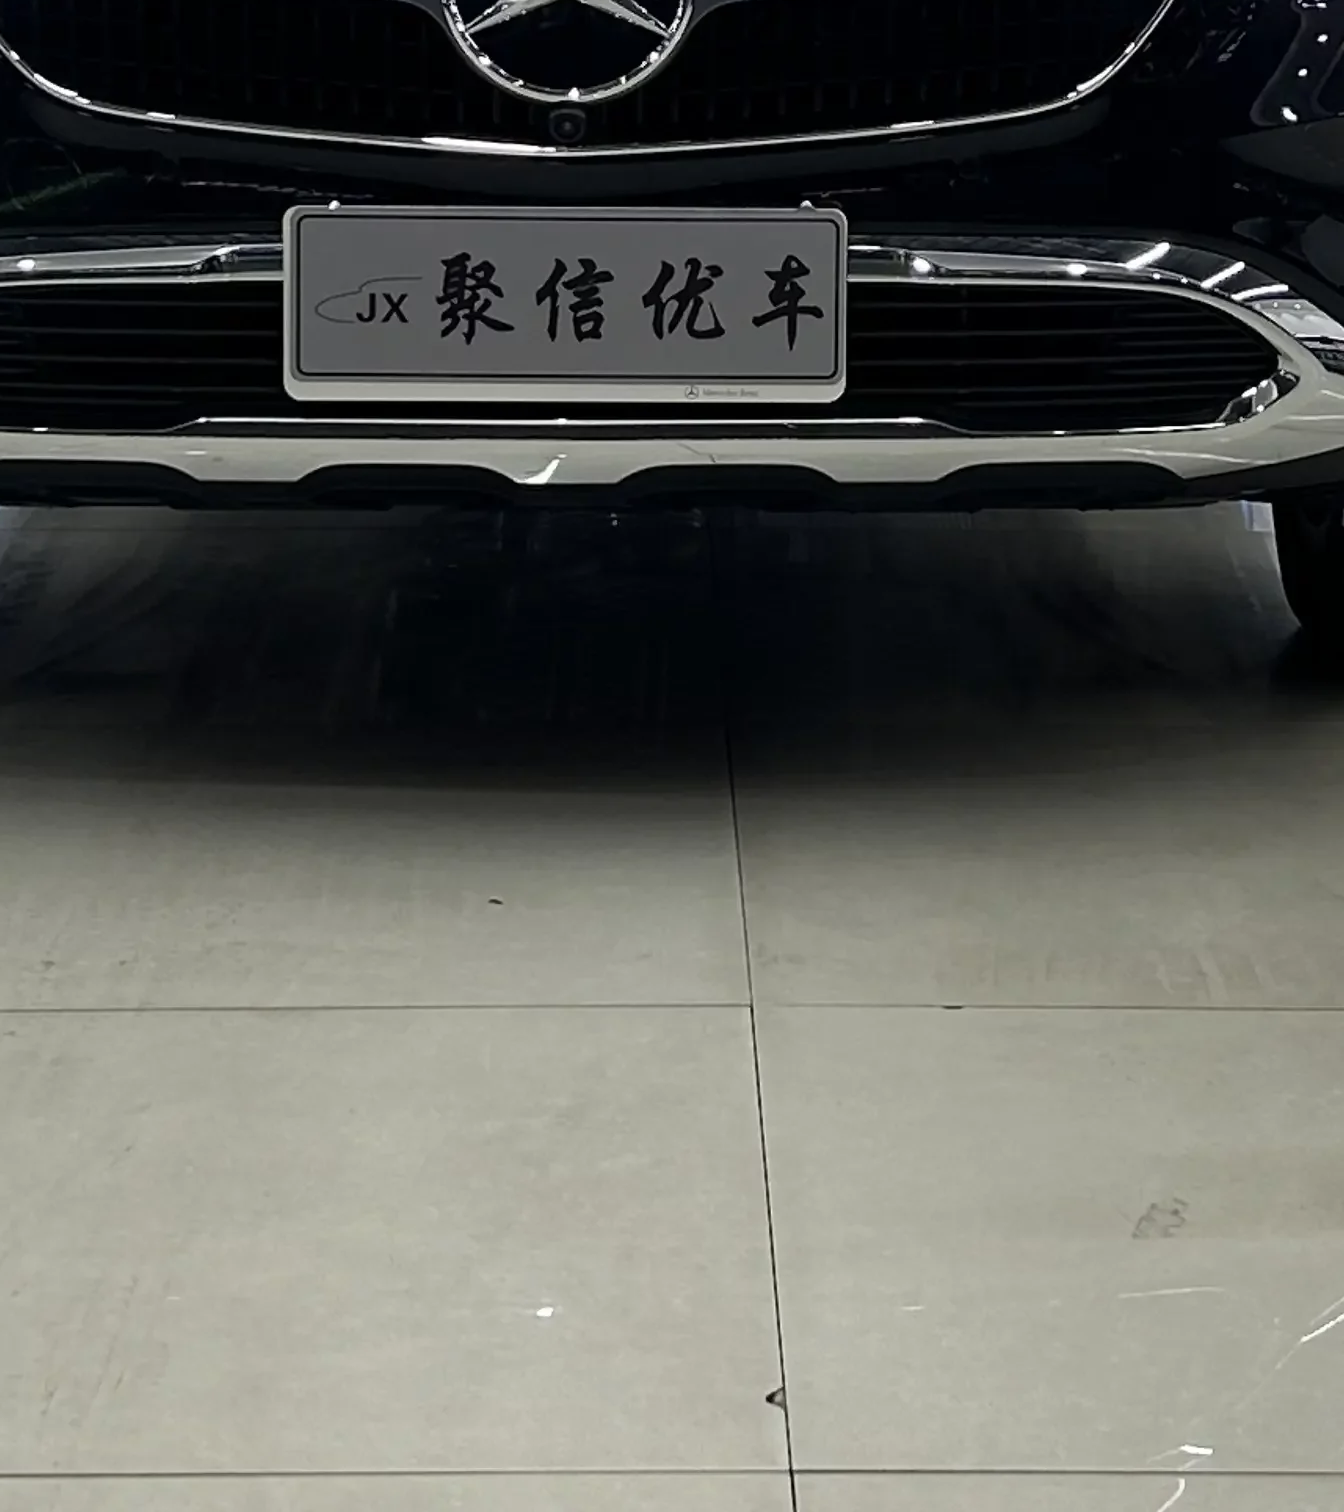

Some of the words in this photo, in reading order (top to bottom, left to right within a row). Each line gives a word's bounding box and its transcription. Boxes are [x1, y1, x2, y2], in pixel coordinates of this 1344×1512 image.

[355, 281, 410, 324] JX
[435, 251, 825, 352] 聚信优车
